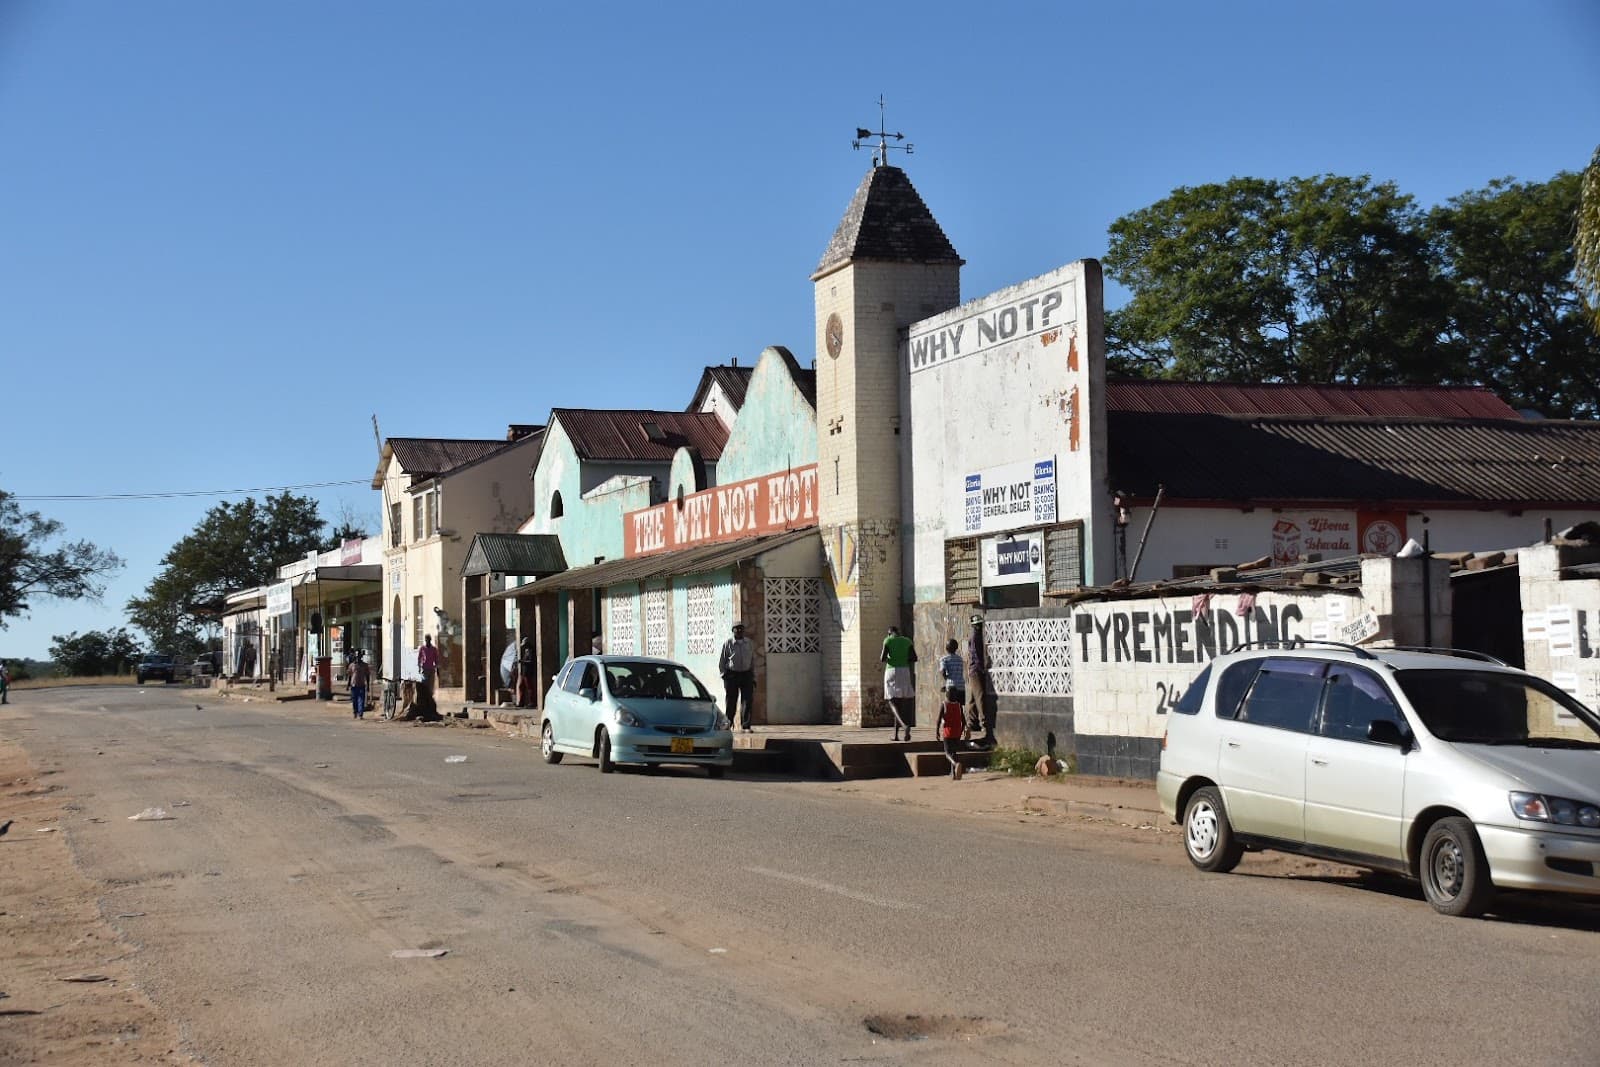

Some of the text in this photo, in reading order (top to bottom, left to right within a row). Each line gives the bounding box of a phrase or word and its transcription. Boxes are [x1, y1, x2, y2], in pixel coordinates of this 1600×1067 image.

[910, 289, 1063, 368] WHY NOT?
[982, 481, 1031, 505] WHY NOT
[1034, 483, 1055, 495] BAKING
[633, 466, 819, 553] THE WHY NOT HOT
[983, 500, 1031, 517] GENERAL DEALER
[1034, 503, 1054, 514] NO ONE
[998, 551, 1013, 565] WHY
[1013, 550, 1026, 564] NOT
